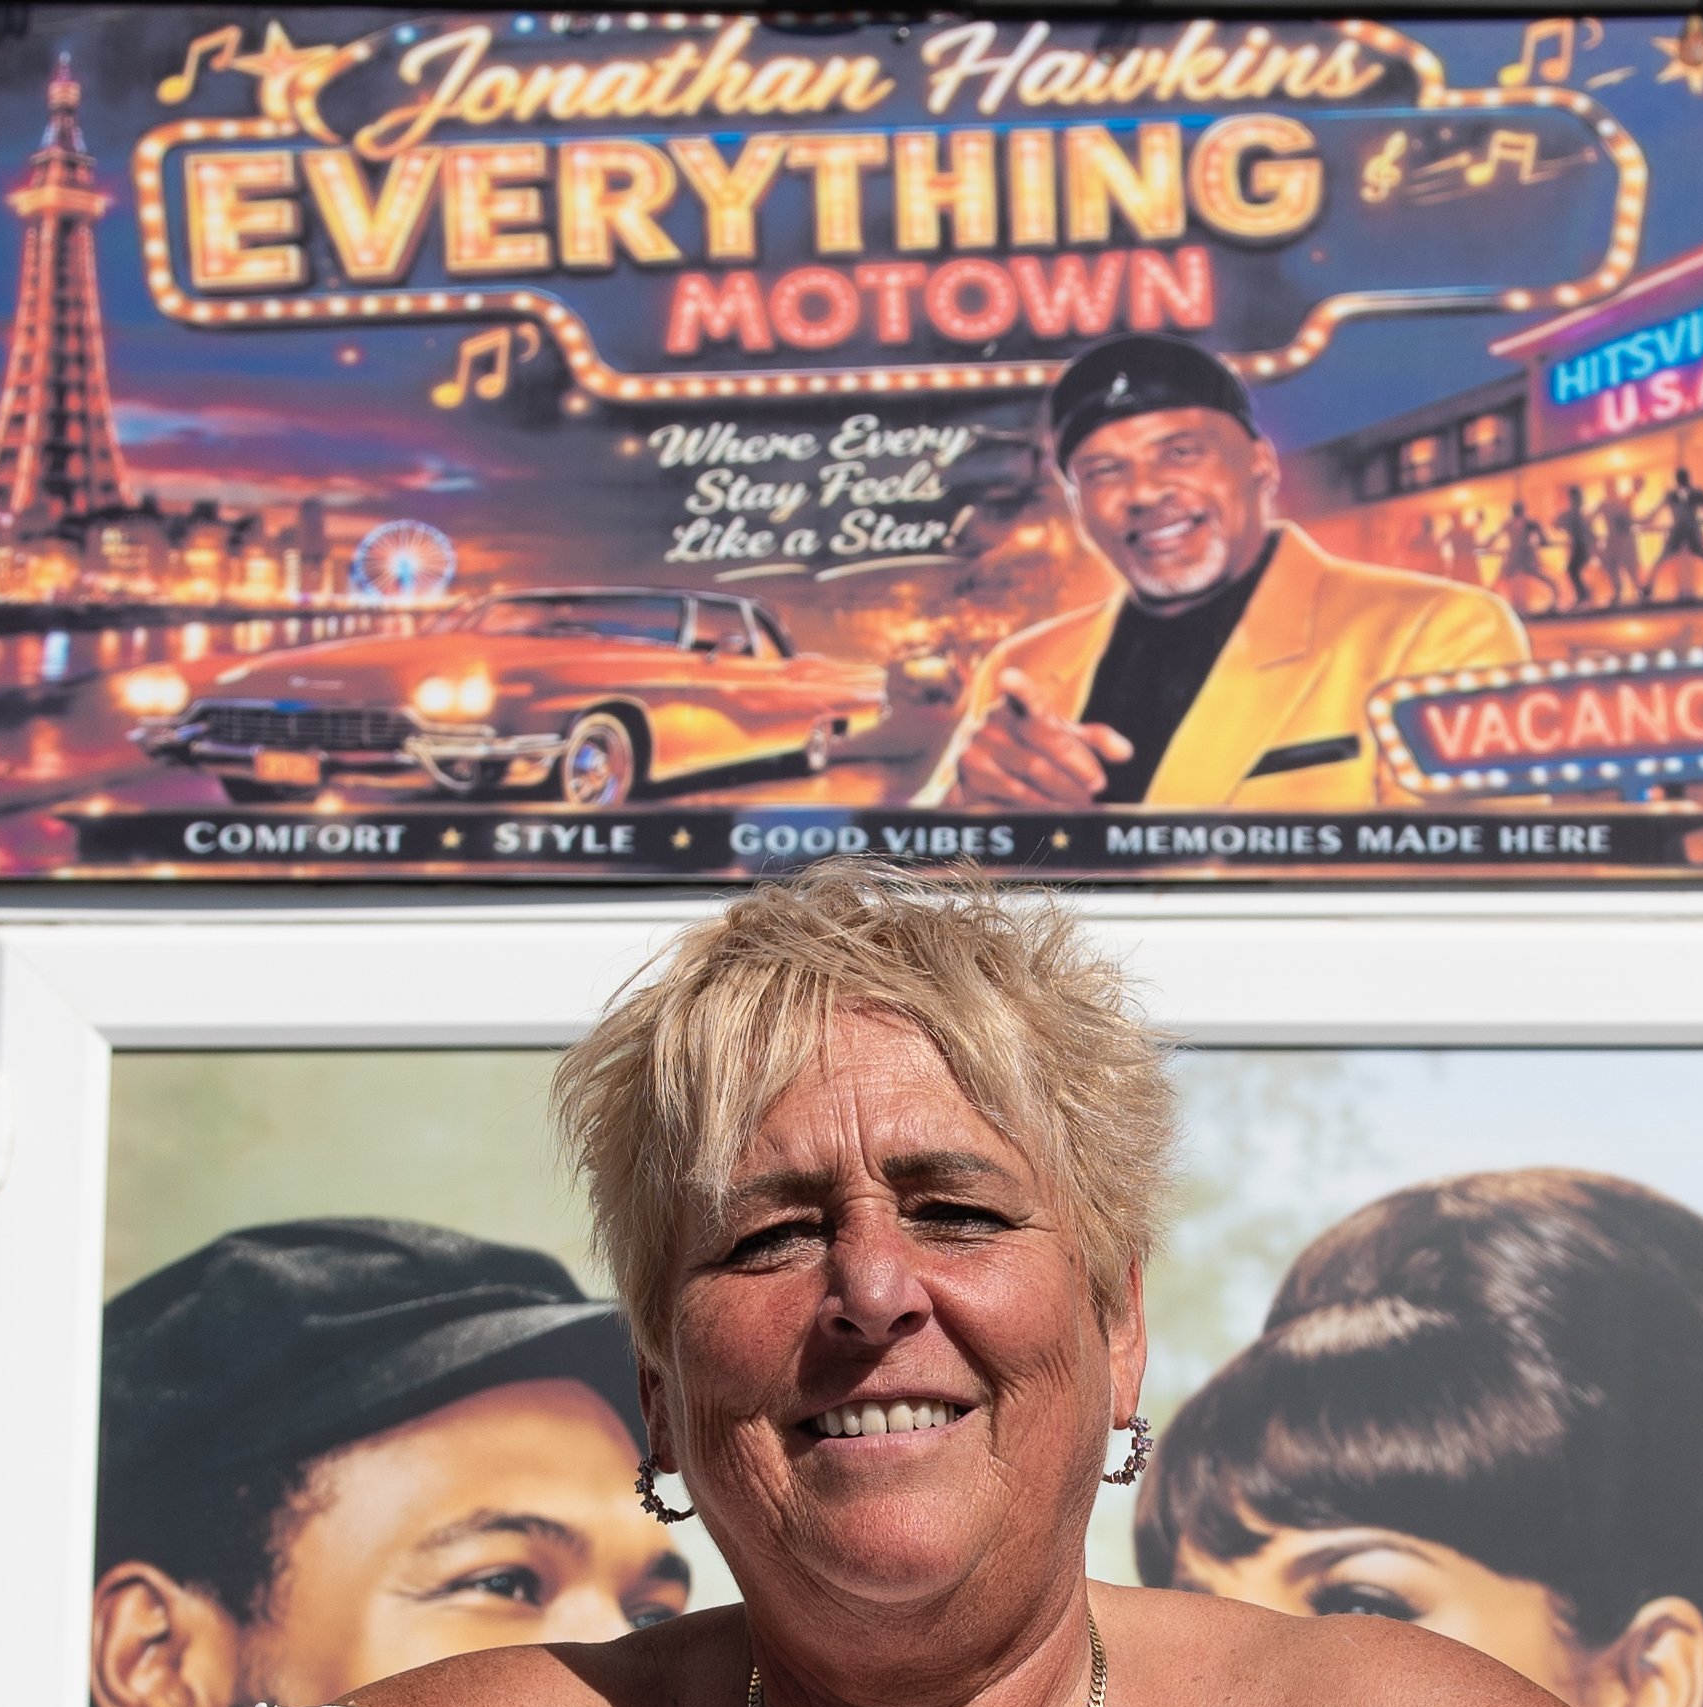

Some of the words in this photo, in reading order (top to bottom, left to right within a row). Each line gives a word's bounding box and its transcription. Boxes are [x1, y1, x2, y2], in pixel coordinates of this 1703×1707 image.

[354, 16, 896, 160] Jonathan
[921, 19, 1384, 115] Hawkins
[184, 113, 1323, 290] EVERYTHING
[665, 246, 1214, 355] MOTOWN
[648, 421, 821, 468] Where
[828, 413, 980, 467] Every
[684, 467, 810, 524] Stay
[818, 459, 950, 508] Feels
[664, 516, 777, 563] Like
[782, 528, 821, 556] a
[829, 504, 975, 555] Star!
[183, 820, 406, 854] COMFORT
[493, 821, 636, 854] STYLE
[729, 822, 869, 855] GOOD
[882, 825, 1015, 856] VIBES
[1106, 824, 1343, 856] MEMORIES
[1357, 824, 1484, 856] MADE
[1498, 824, 1613, 856] HERE
